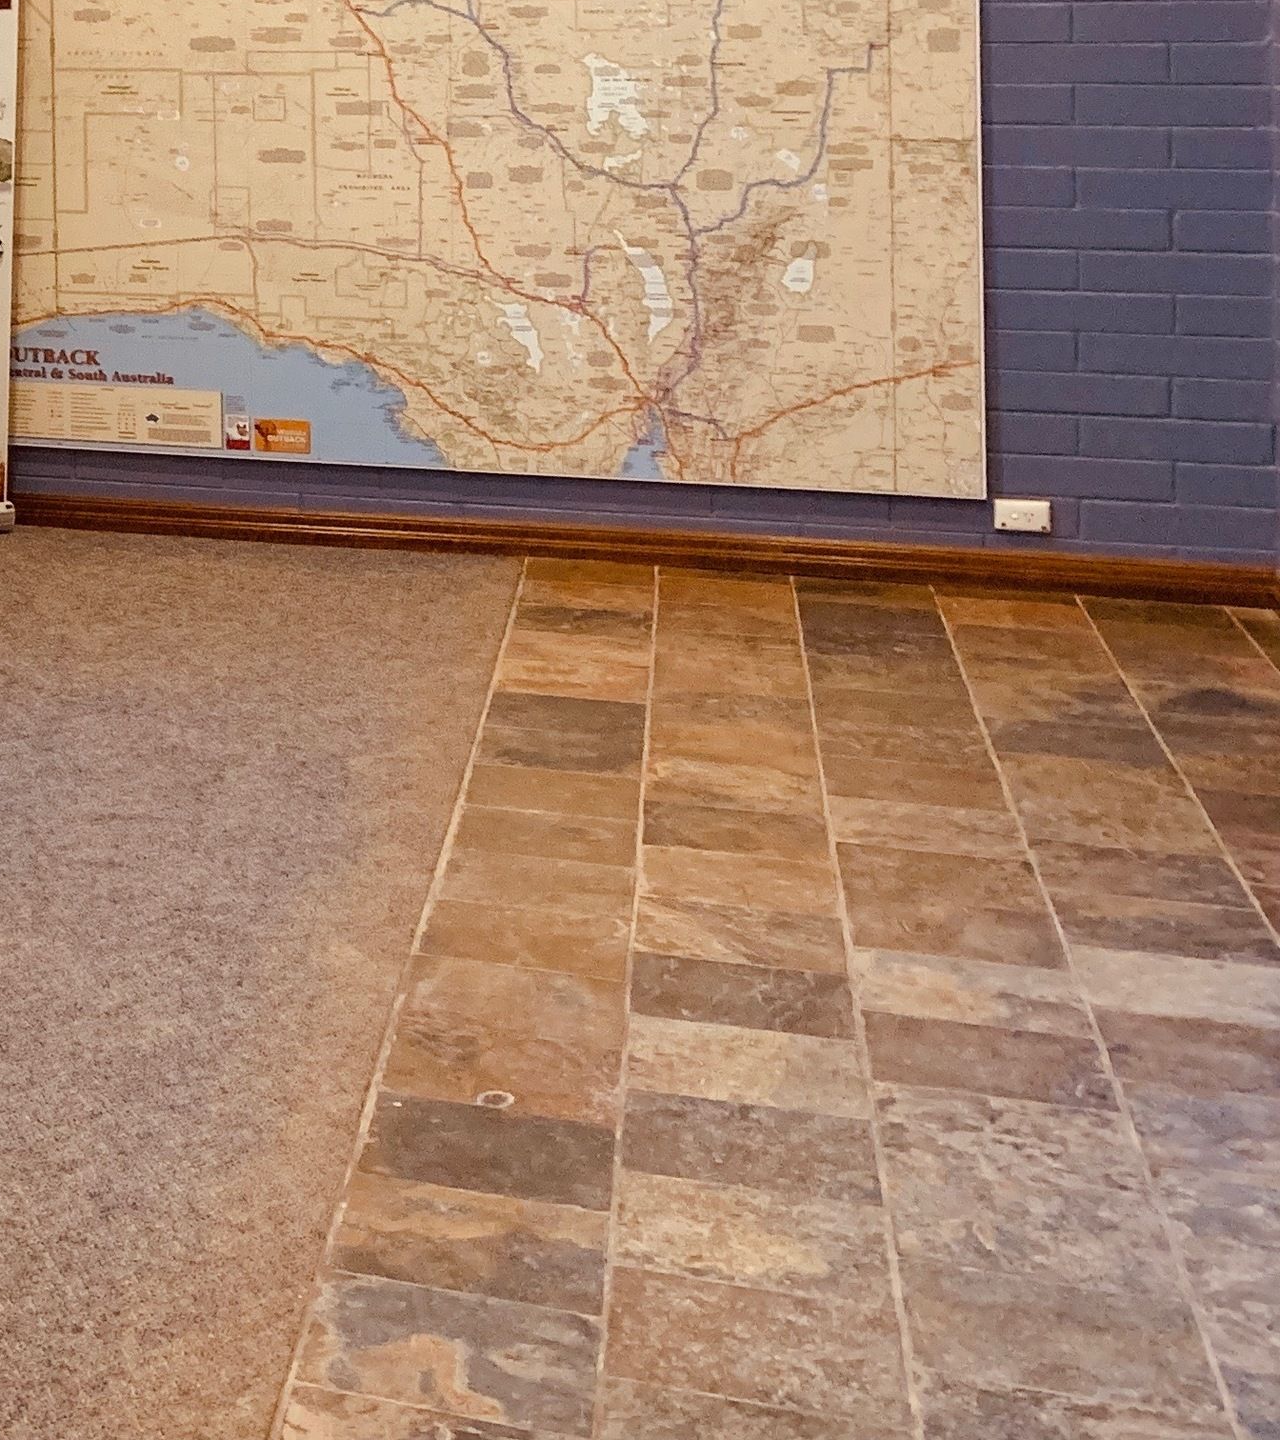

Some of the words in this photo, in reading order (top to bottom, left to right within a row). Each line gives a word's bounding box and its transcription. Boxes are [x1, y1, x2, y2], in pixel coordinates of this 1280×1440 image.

[10, 367, 47, 379] entral
[50, 368, 64, 379] &
[68, 368, 108, 382] South
[112, 371, 175, 385] Australia
